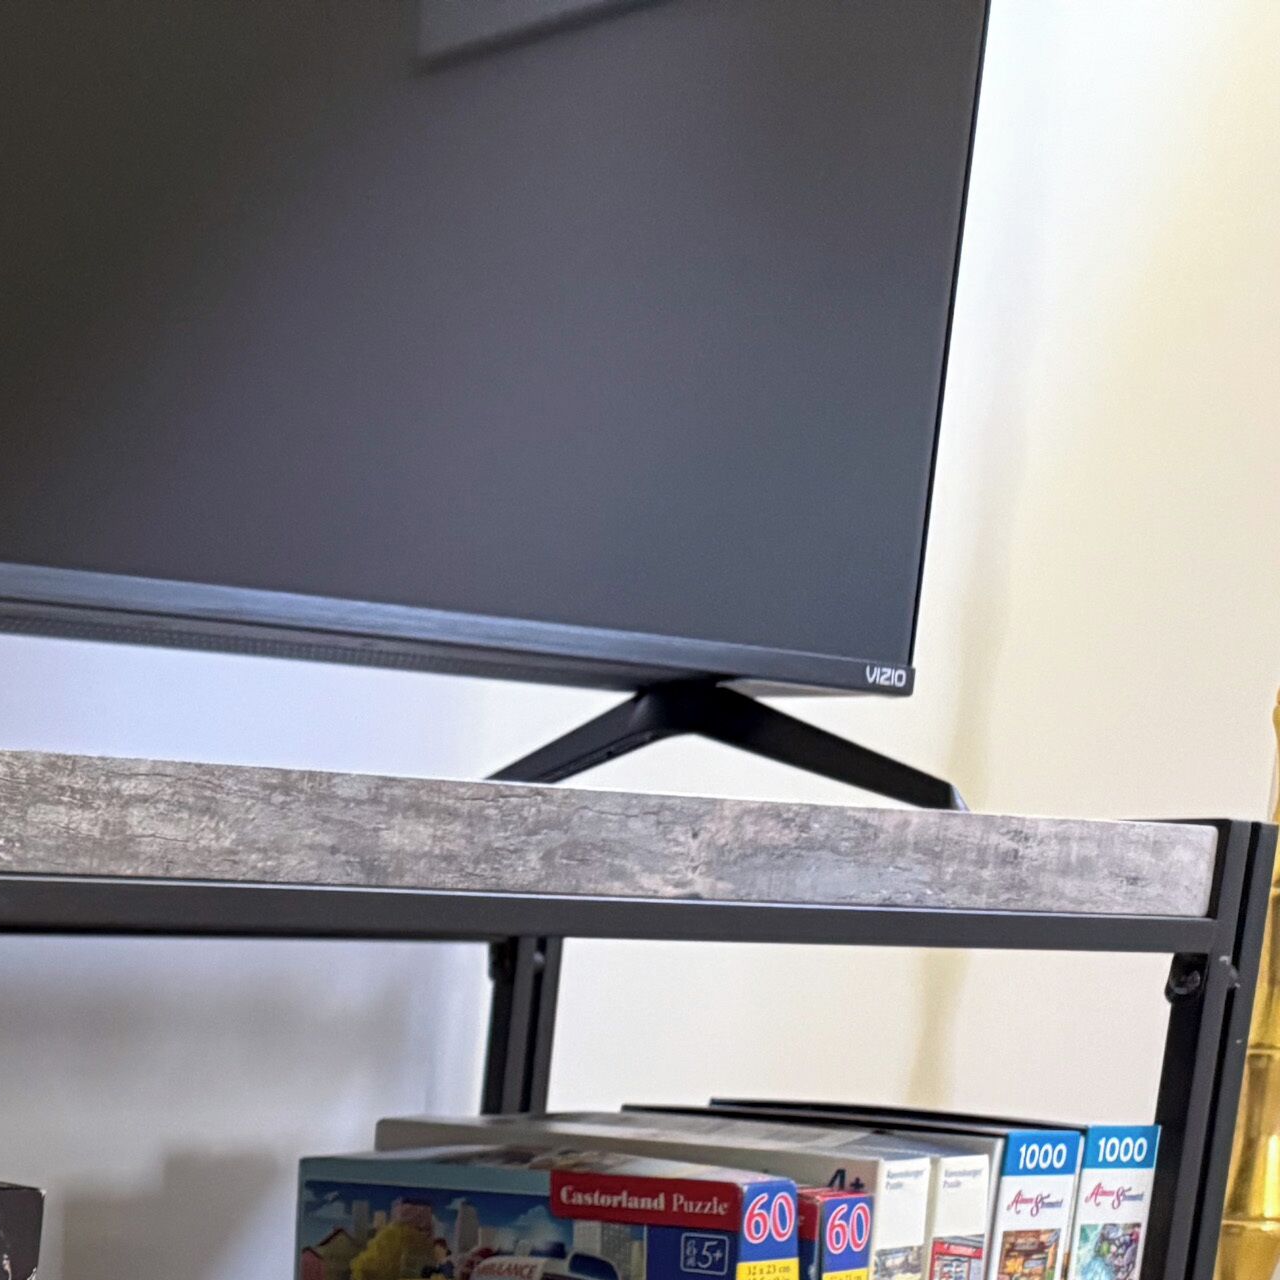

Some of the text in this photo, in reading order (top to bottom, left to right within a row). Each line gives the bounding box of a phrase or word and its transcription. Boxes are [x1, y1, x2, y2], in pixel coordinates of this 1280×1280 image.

[866, 665, 907, 687] VIZIO
[1019, 1143, 1068, 1170] 1000
[1098, 1137, 1148, 1163] 1000
[560, 1185, 729, 1216] Castorland Puzzle
[744, 1191, 796, 1244] 60
[826, 1202, 871, 1255] 60
[697, 1240, 723, 1269] 5+
